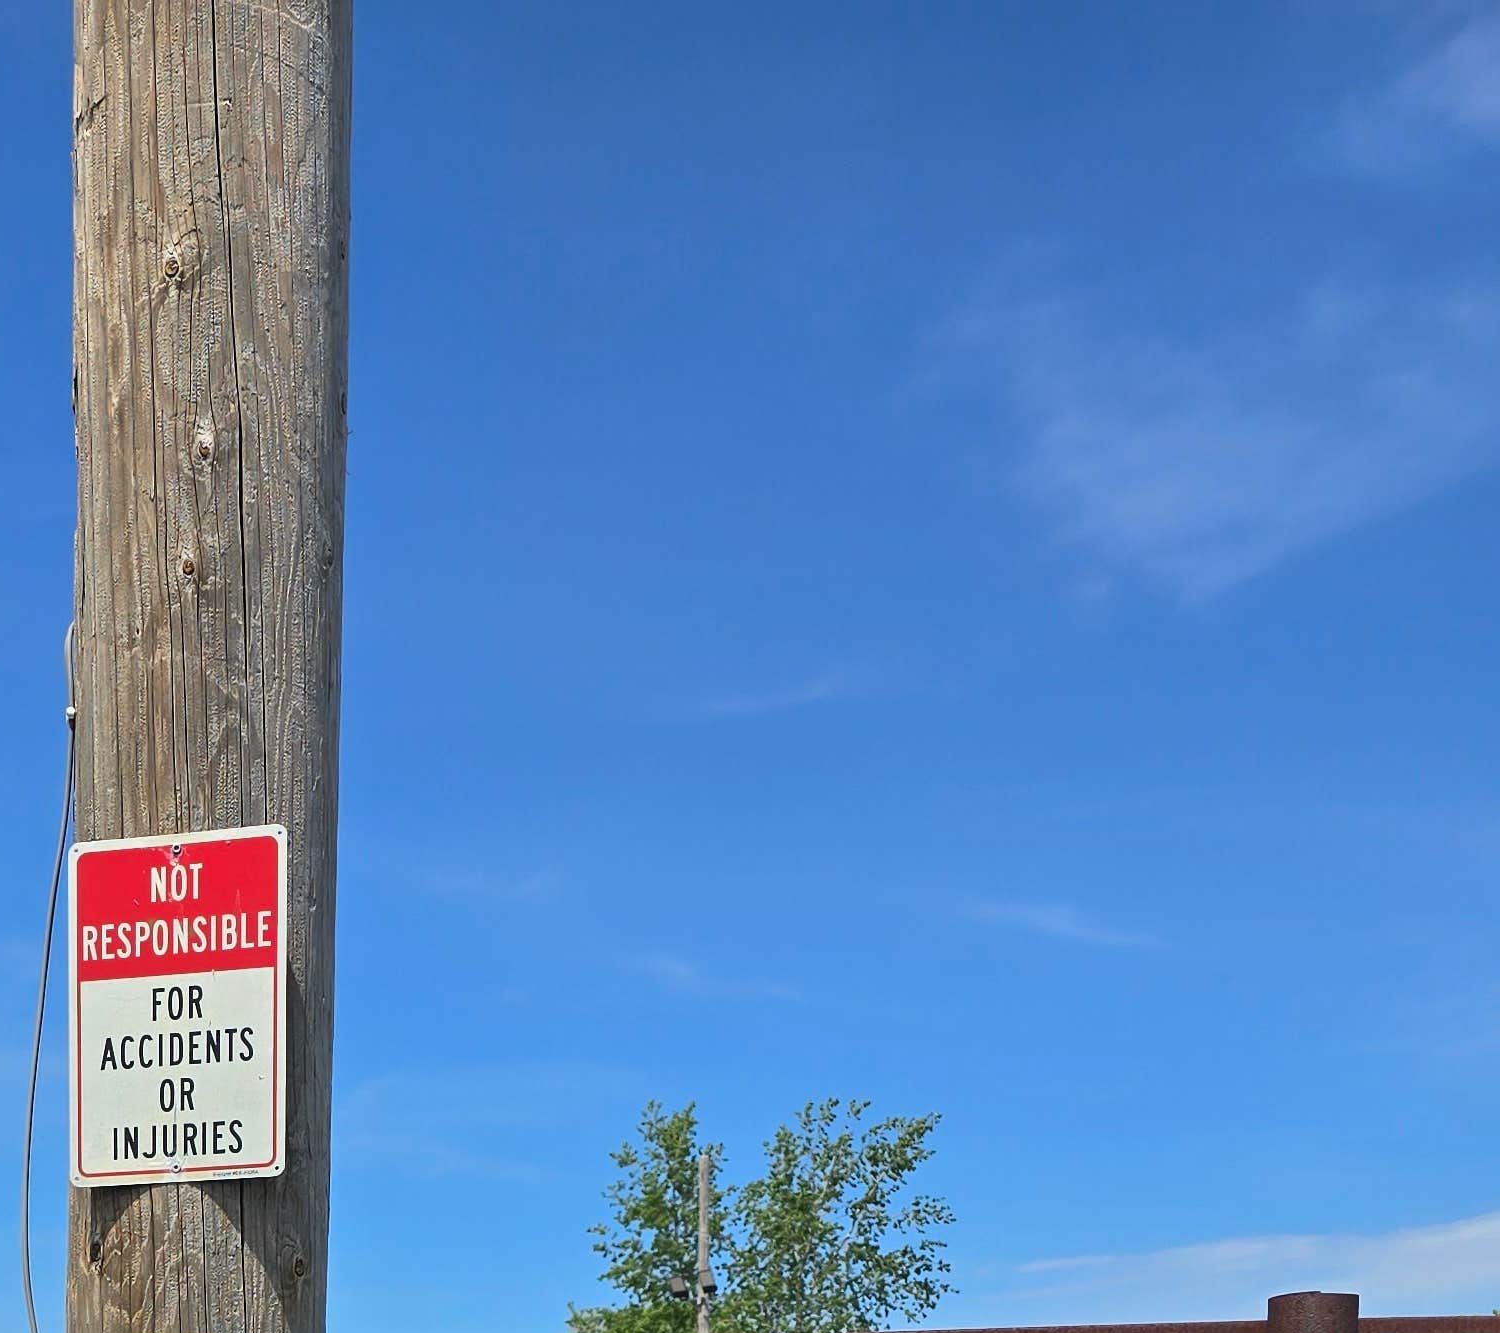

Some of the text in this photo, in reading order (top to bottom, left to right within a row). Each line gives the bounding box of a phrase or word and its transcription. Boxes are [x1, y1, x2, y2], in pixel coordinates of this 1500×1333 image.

[151, 863, 202, 902] NOT
[83, 911, 271, 961] RESPONSIBLE
[153, 986, 202, 1021] FOR
[101, 1028, 253, 1070] ACCIDENTS
[160, 1078, 194, 1112] OR
[114, 1120, 242, 1160] INJURIES
